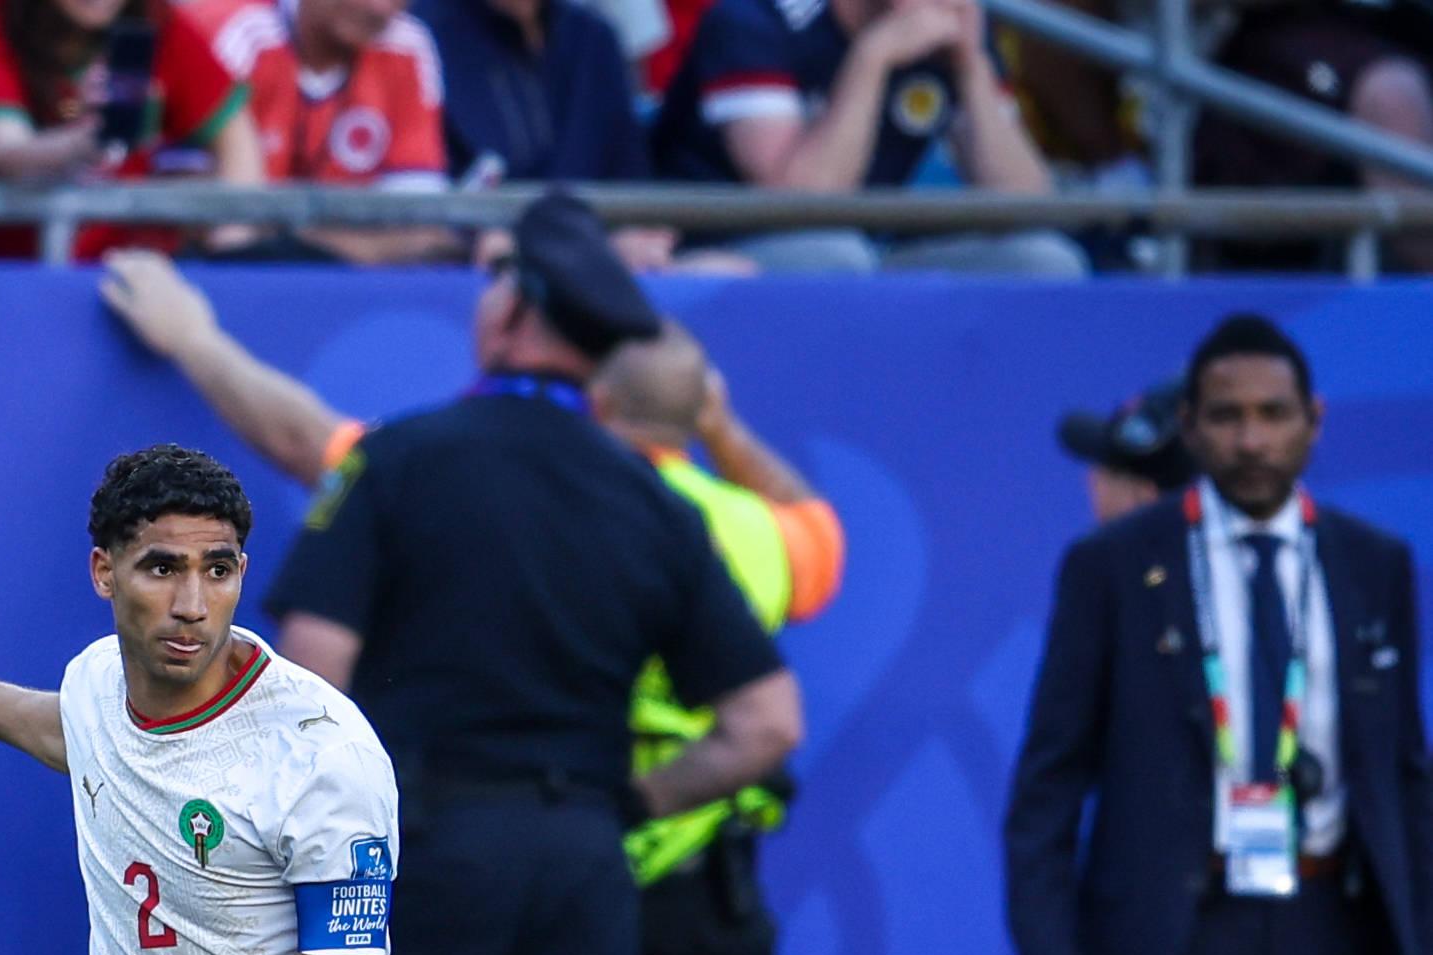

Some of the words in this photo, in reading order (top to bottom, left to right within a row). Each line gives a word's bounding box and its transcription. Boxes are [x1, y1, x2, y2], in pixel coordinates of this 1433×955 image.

[332, 884, 387, 899] FOOTBALL
[123, 861, 178, 949] 2
[332, 898, 386, 917] UNITES
[327, 918, 351, 934] the
[352, 915, 387, 932] World
[347, 934, 371, 944] FIFA
